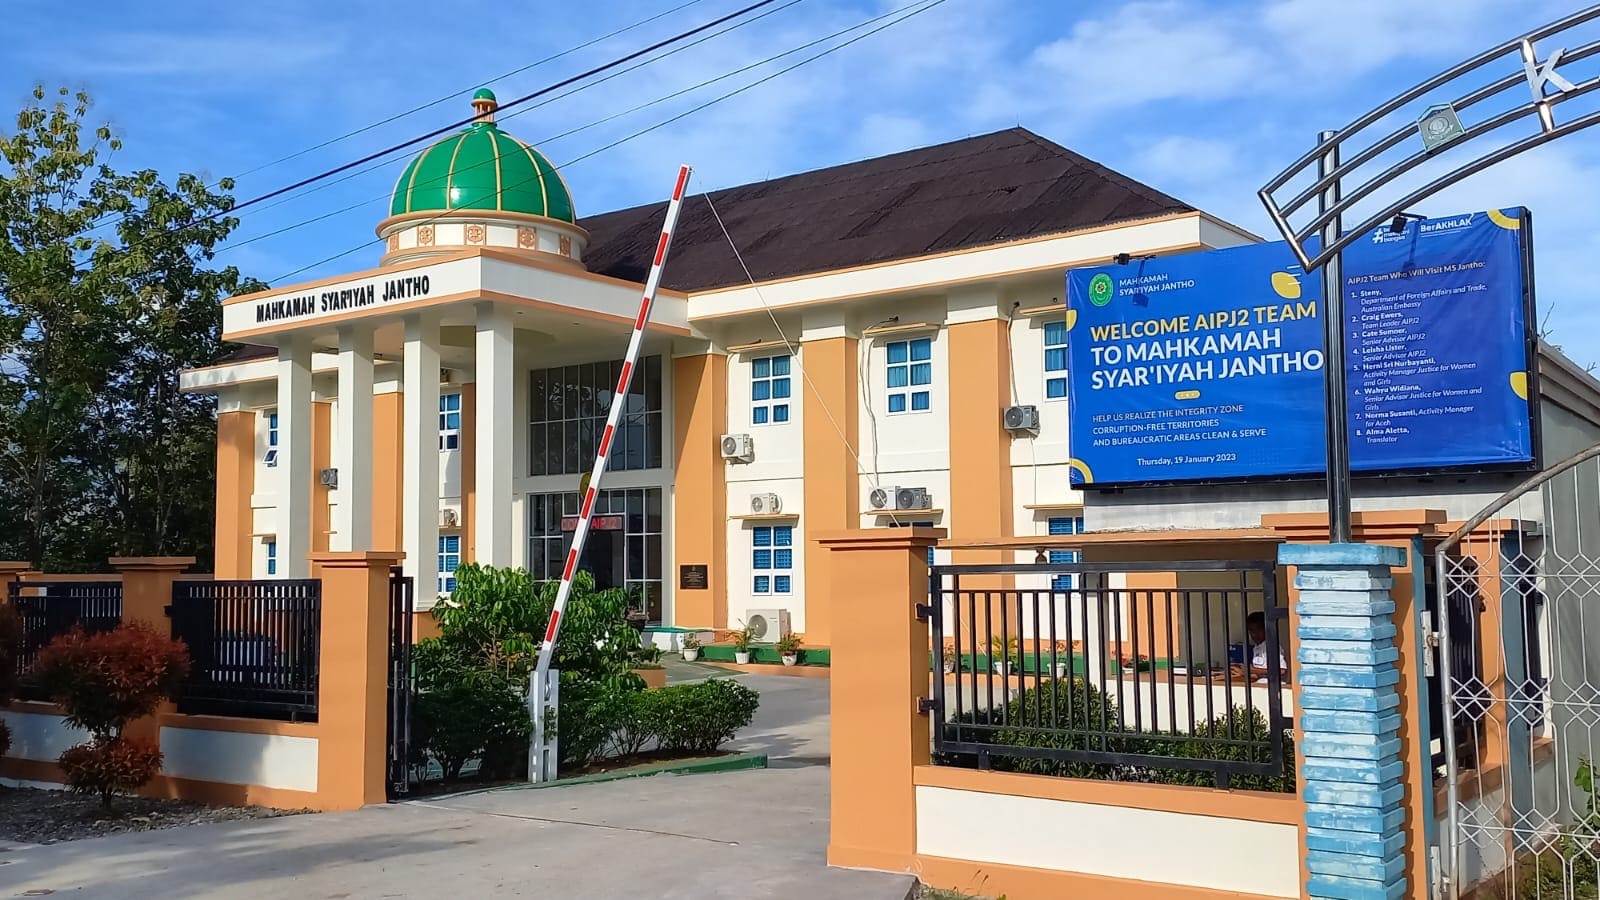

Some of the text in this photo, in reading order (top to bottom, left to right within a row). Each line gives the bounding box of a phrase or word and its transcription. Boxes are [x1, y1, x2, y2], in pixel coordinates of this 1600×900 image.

[1421, 214, 1472, 232] BerAKHLAK
[1119, 273, 1168, 286] MAHKAMAH
[1348, 277, 1368, 285] AIPJ2
[1370, 274, 1389, 282] Team
[1408, 268, 1424, 277] Will
[1424, 266, 1442, 275] Visit
[1444, 265, 1456, 274] MS
[1457, 261, 1486, 271] Jantho:
[1119, 280, 1195, 296] SYAR'IYAH JANTHO
[256, 275, 429, 322] MAHKAMAH SYAR'IYAH JANTHO
[1361, 293, 1397, 305] Department
[1398, 292, 1406, 300] of
[1407, 290, 1430, 300] Foreign
[1431, 287, 1452, 296] Affairs
[1361, 301, 1421, 313] Australian Embassy
[1089, 301, 1317, 343] WELCOME AIPJ2 TEAM
[1362, 321, 1378, 330] Team
[1091, 328, 1281, 365] TO MAHKAMAH
[1362, 337, 1382, 346] Senior
[1407, 333, 1426, 341] AIPJ2
[1362, 346, 1384, 354] Leisha
[1362, 354, 1382, 362] Senior
[1383, 352, 1406, 360] Advisor
[1091, 350, 1324, 390] SYAR'IYAH JANTHO
[1363, 369, 1388, 378] Activity
[1388, 368, 1416, 376] Manager
[1364, 395, 1384, 403] Senior
[1409, 391, 1432, 399] Justice
[1442, 388, 1468, 396] Women
[1093, 405, 1243, 423] HELP US REALIZE THE INTEGRITY ZONE
[1418, 407, 1444, 415] Activity
[1093, 419, 1219, 435] CORRUPTION-FREE TERRITORIES
[1093, 428, 1267, 447] AND BUREAUCRATIC AREAS CLEAN & SERVE
[1366, 436, 1398, 444] Translator
[1137, 456, 1173, 467] Thursday,
[1184, 455, 1215, 465] January
[1215, 453, 1236, 462] 2023
